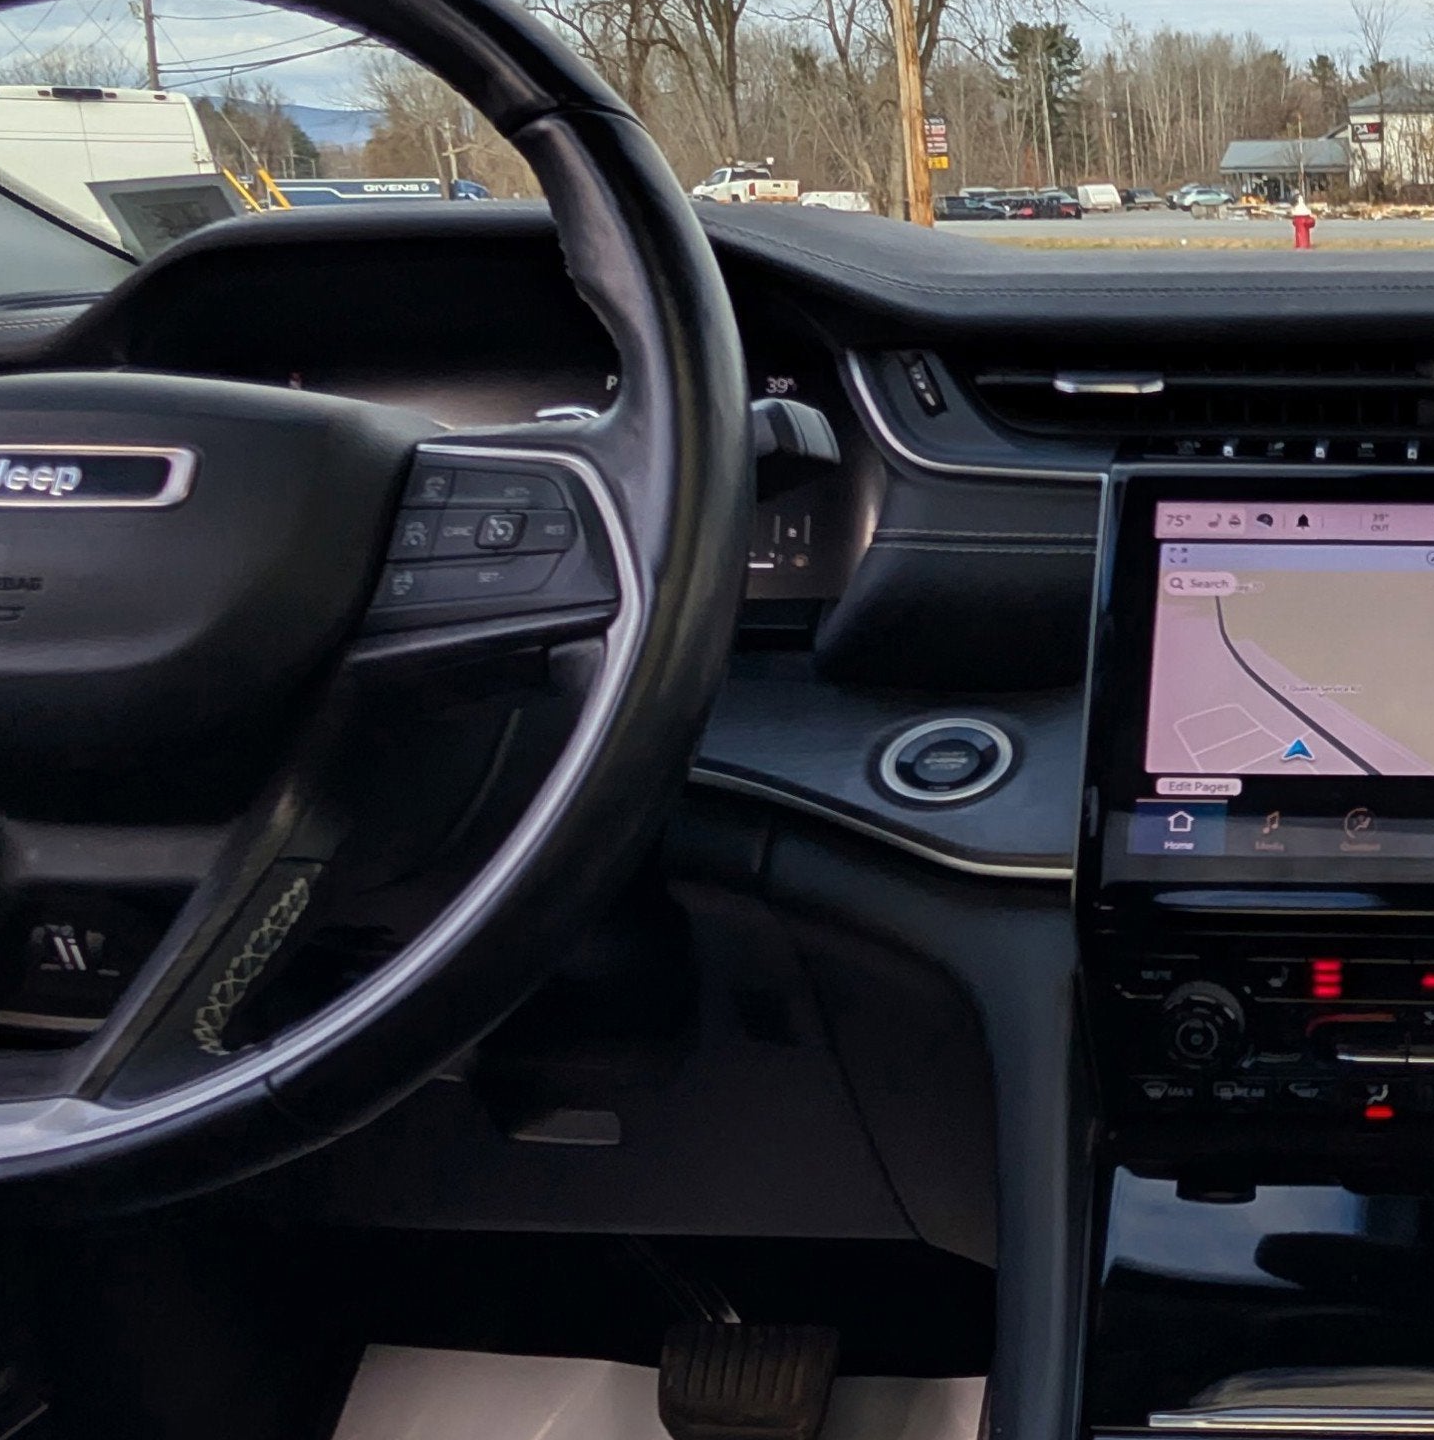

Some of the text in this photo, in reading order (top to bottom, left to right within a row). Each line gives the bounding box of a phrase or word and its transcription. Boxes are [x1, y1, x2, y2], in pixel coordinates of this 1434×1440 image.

[363, 184, 420, 192] GIVENS
[606, 375, 618, 391] P
[1165, 514, 1192, 528] 75°
[1189, 578, 1230, 591] Search
[1169, 781, 1230, 794] Edit Pages
[1163, 840, 1195, 851] Home
